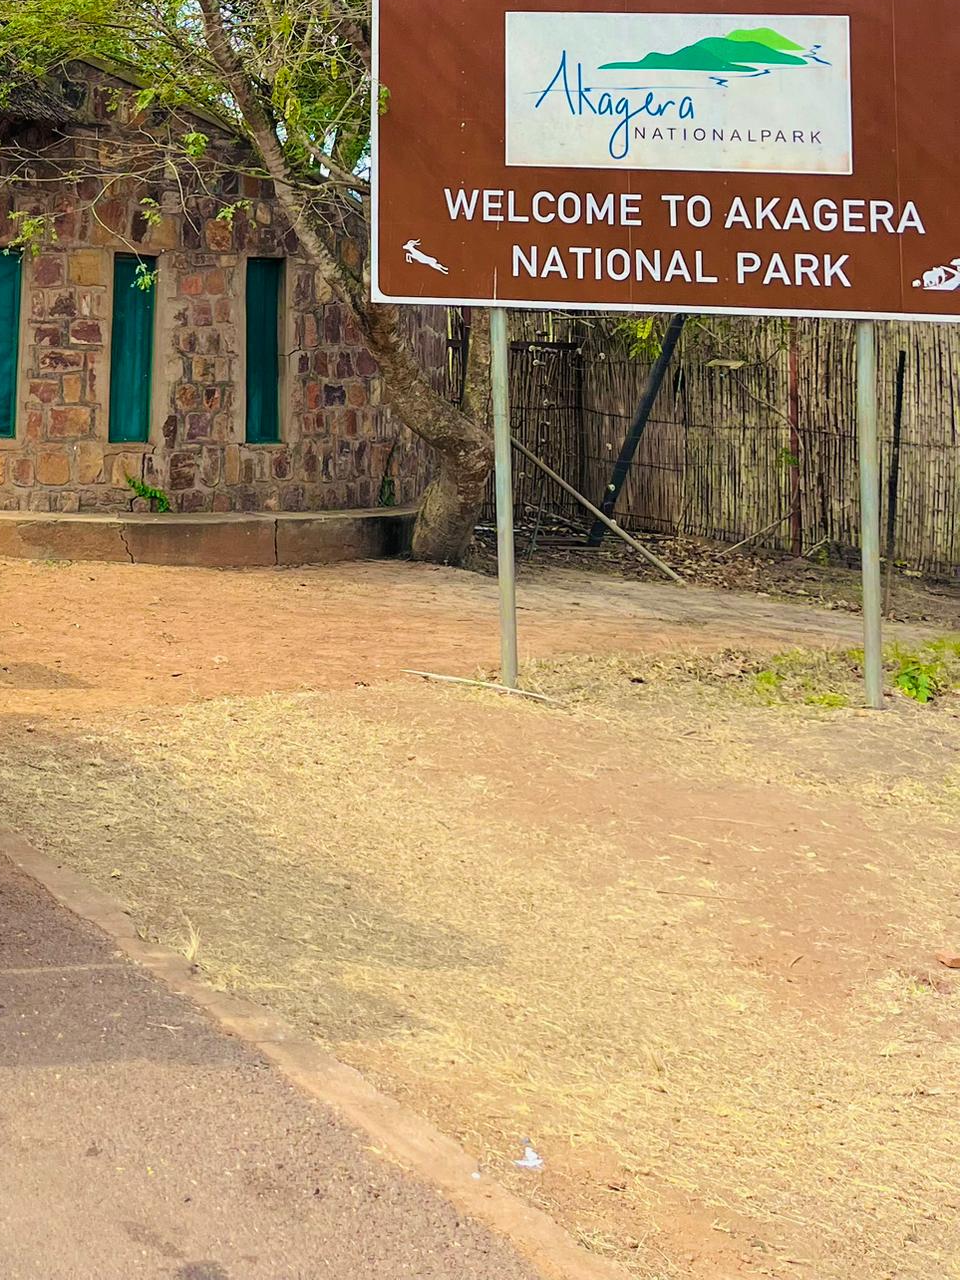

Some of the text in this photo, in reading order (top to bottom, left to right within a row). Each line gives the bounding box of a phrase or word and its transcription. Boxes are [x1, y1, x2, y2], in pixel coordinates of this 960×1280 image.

[534, 50, 695, 160] Akagera
[443, 187, 927, 235] WELCOME TO AKAGERA
[511, 244, 853, 288] NATIONAL PARK
